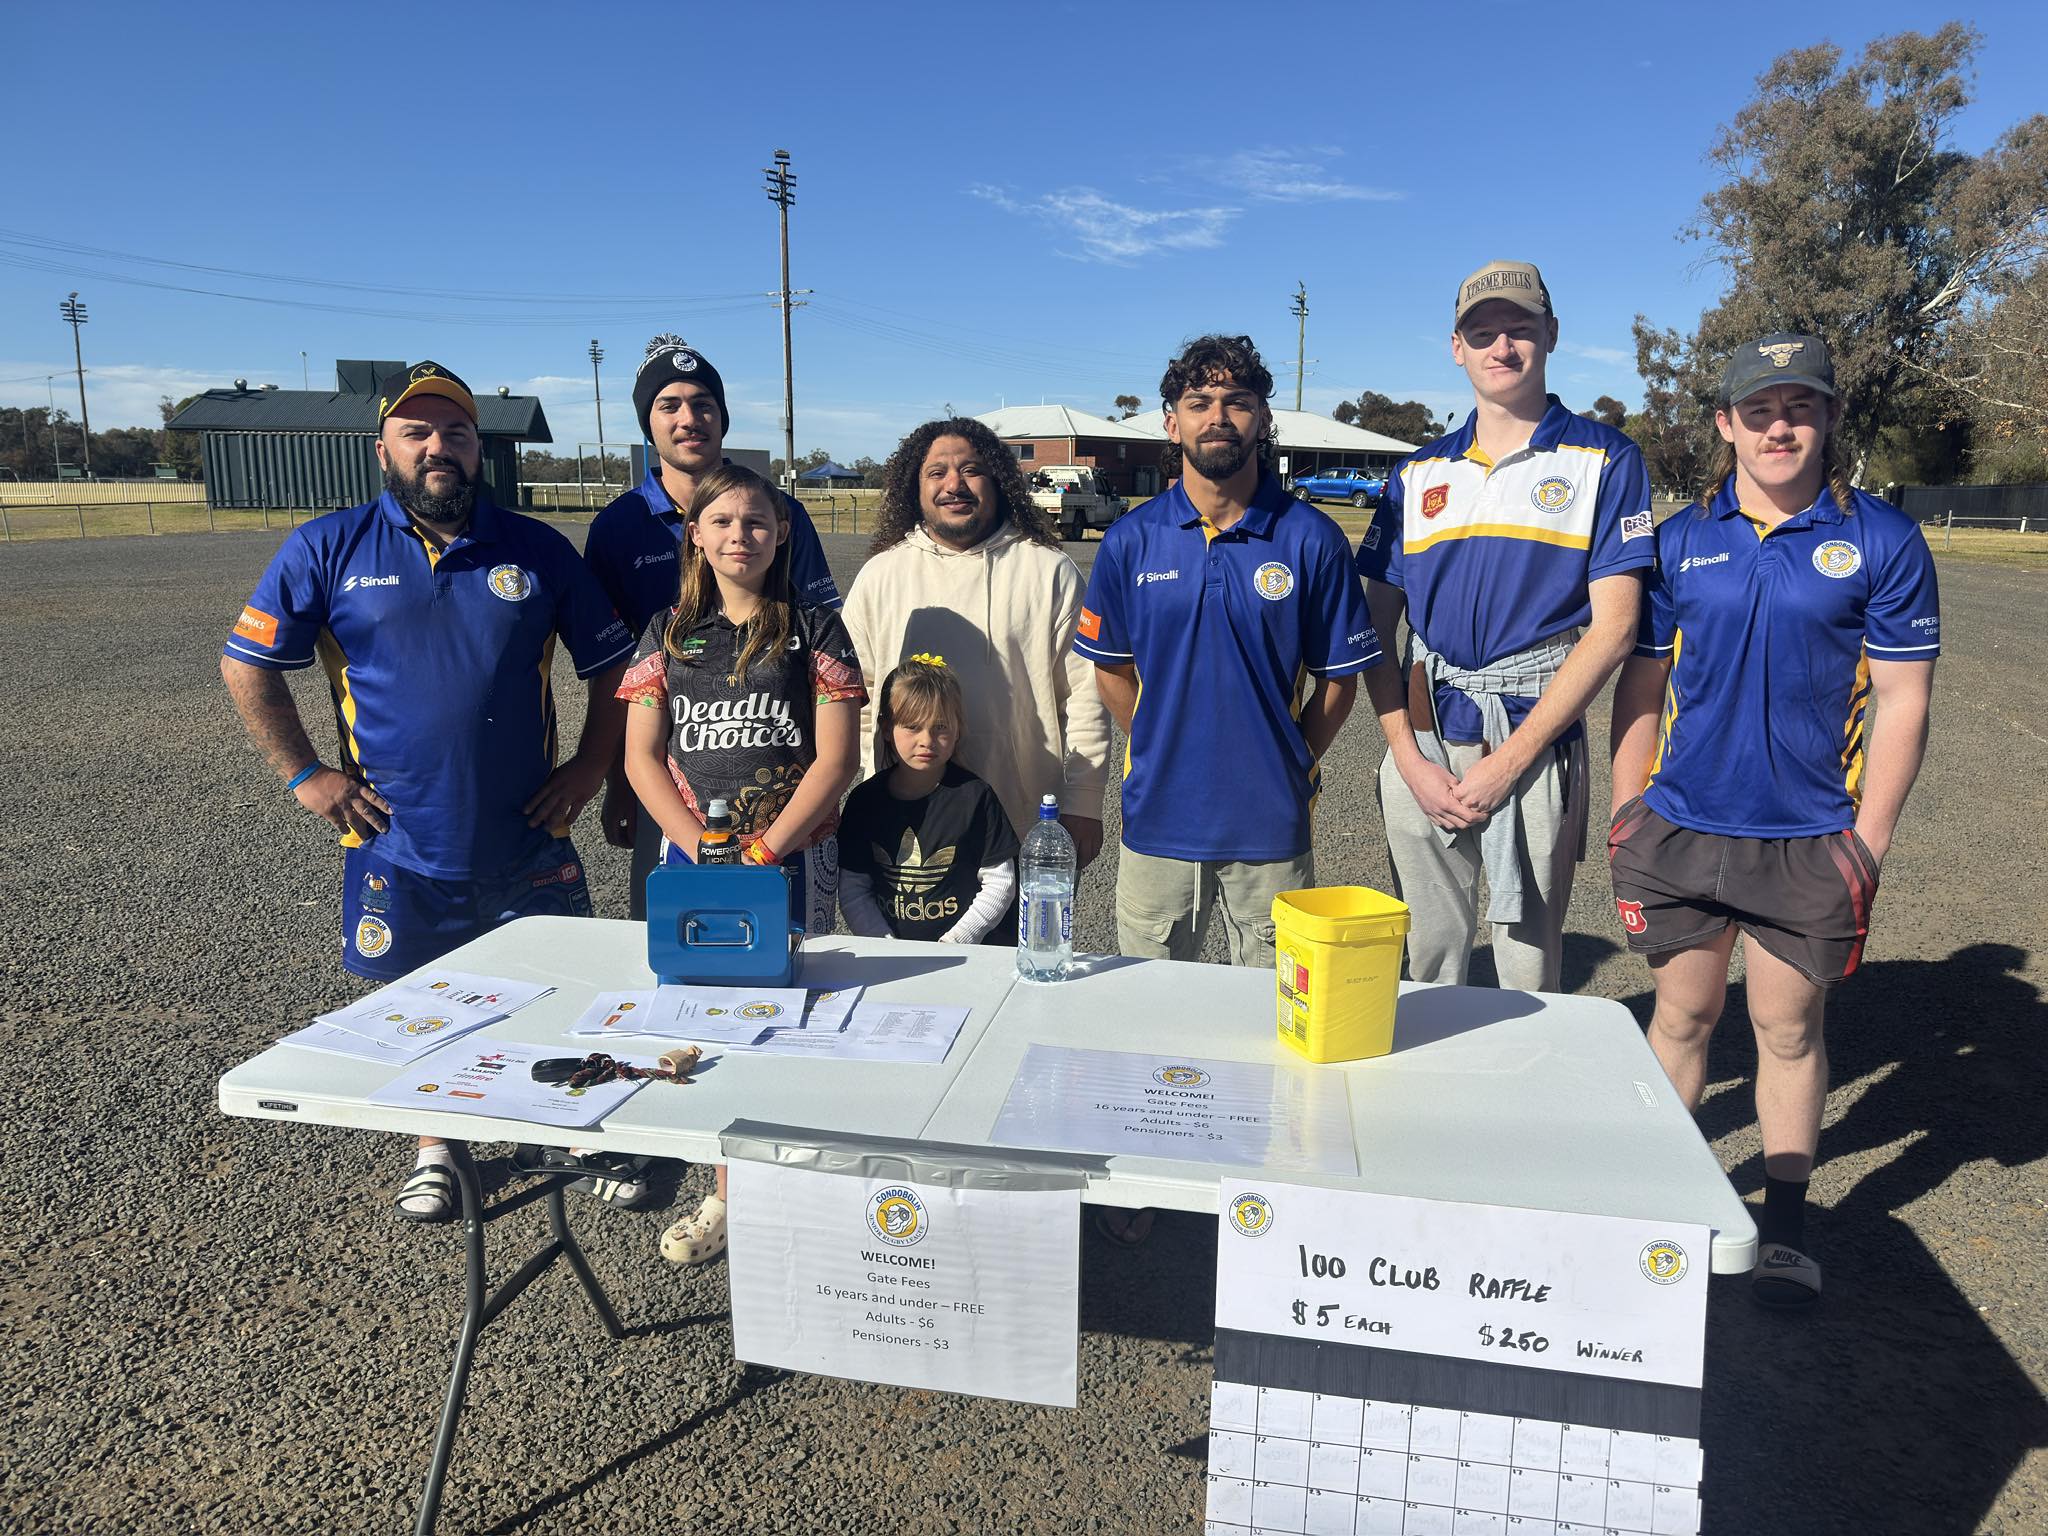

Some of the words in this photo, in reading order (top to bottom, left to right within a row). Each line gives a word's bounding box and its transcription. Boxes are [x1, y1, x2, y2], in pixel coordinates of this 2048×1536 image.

[1501, 271, 1532, 289] BULLS
[673, 692, 796, 731] Deadly
[679, 719, 802, 752] Choices
[885, 895, 959, 921] adidas
[1062, 910, 1070, 936] super
[1144, 1088, 1215, 1100] WELCOME!
[1147, 1098, 1177, 1108] Gate
[1181, 1100, 1208, 1110] Fees
[1095, 1103, 1110, 1111] 16
[1112, 1106, 1146, 1116] years
[1149, 1107, 1174, 1116] and
[1177, 1109, 1214, 1119] under
[1229, 1115, 1260, 1123] FREE
[1140, 1116, 1182, 1127] Adults
[1193, 1120, 1210, 1129] $6
[1124, 1125, 1195, 1138] Pensioners
[1207, 1132, 1223, 1142] $3
[875, 1189, 922, 1212] CONDOBOLIN
[1233, 1194, 1267, 1208] CONDOBOLIN
[869, 1213, 883, 1237] SENIOR
[882, 1234, 905, 1245] RUGBY
[905, 1223, 925, 1244] LEAGUE
[1647, 1242, 1684, 1256] CONDOBOLIN
[861, 1250, 936, 1270] WELCOME!
[867, 1272, 897, 1286] Gate
[901, 1275, 930, 1289] Fees
[1299, 1244, 1346, 1278] 100
[1369, 1256, 1441, 1291] CLUB
[1469, 1272, 1552, 1303] RAFFLE
[816, 1284, 831, 1296] 16
[834, 1288, 868, 1303] years
[872, 1291, 895, 1306] and
[899, 1295, 938, 1310] under
[953, 1302, 985, 1315] FREE
[865, 1311, 906, 1326] Adults
[918, 1317, 935, 1330] $6
[852, 1329, 921, 1348] Pensioners
[934, 1338, 950, 1350] $3
[1344, 1315, 1393, 1335] EACH
[1478, 1323, 1550, 1352] $250
[1512, 1468, 1523, 1476] 17
[1562, 1474, 1573, 1482] 18
[1610, 1480, 1620, 1489] 19
[1359, 1496, 1371, 1504] 24
[1509, 1516, 1522, 1524] 27
